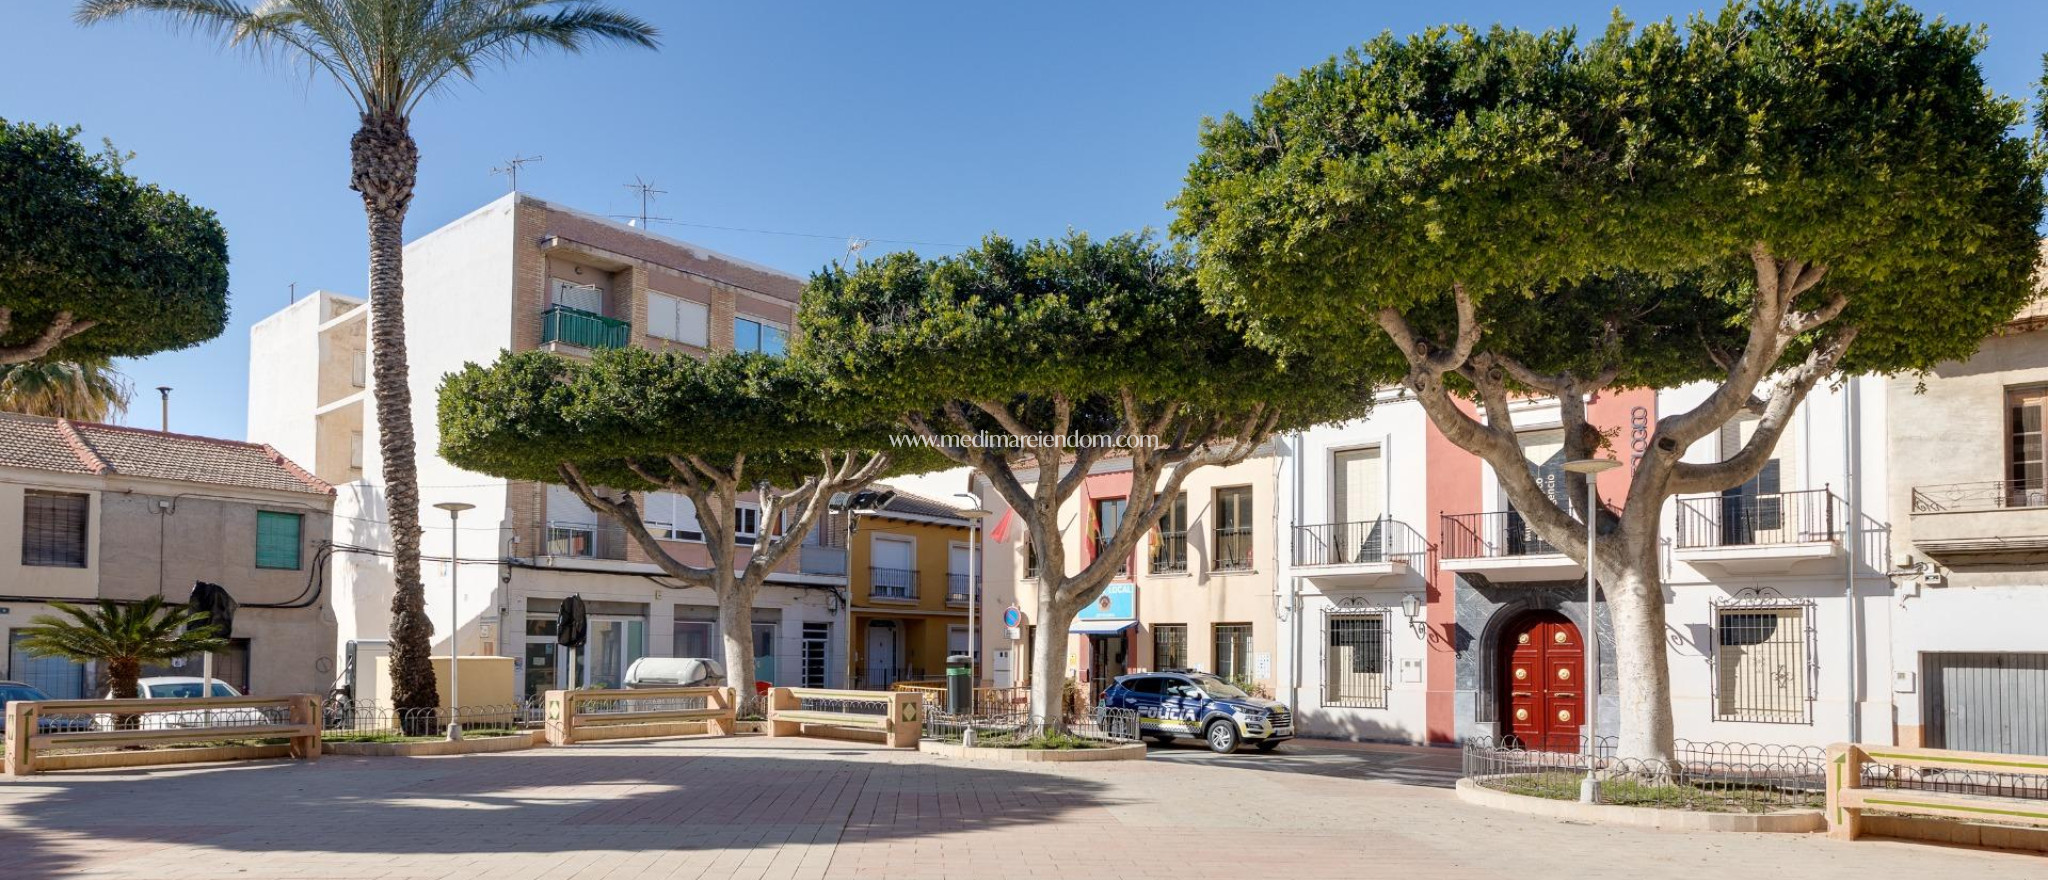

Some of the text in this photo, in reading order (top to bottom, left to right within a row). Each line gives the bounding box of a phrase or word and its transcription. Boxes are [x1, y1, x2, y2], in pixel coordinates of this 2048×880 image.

[1631, 406, 1648, 478] OLOGICO
[1109, 584, 1132, 594] LOCAL
[1138, 705, 1196, 721] POLICIA
